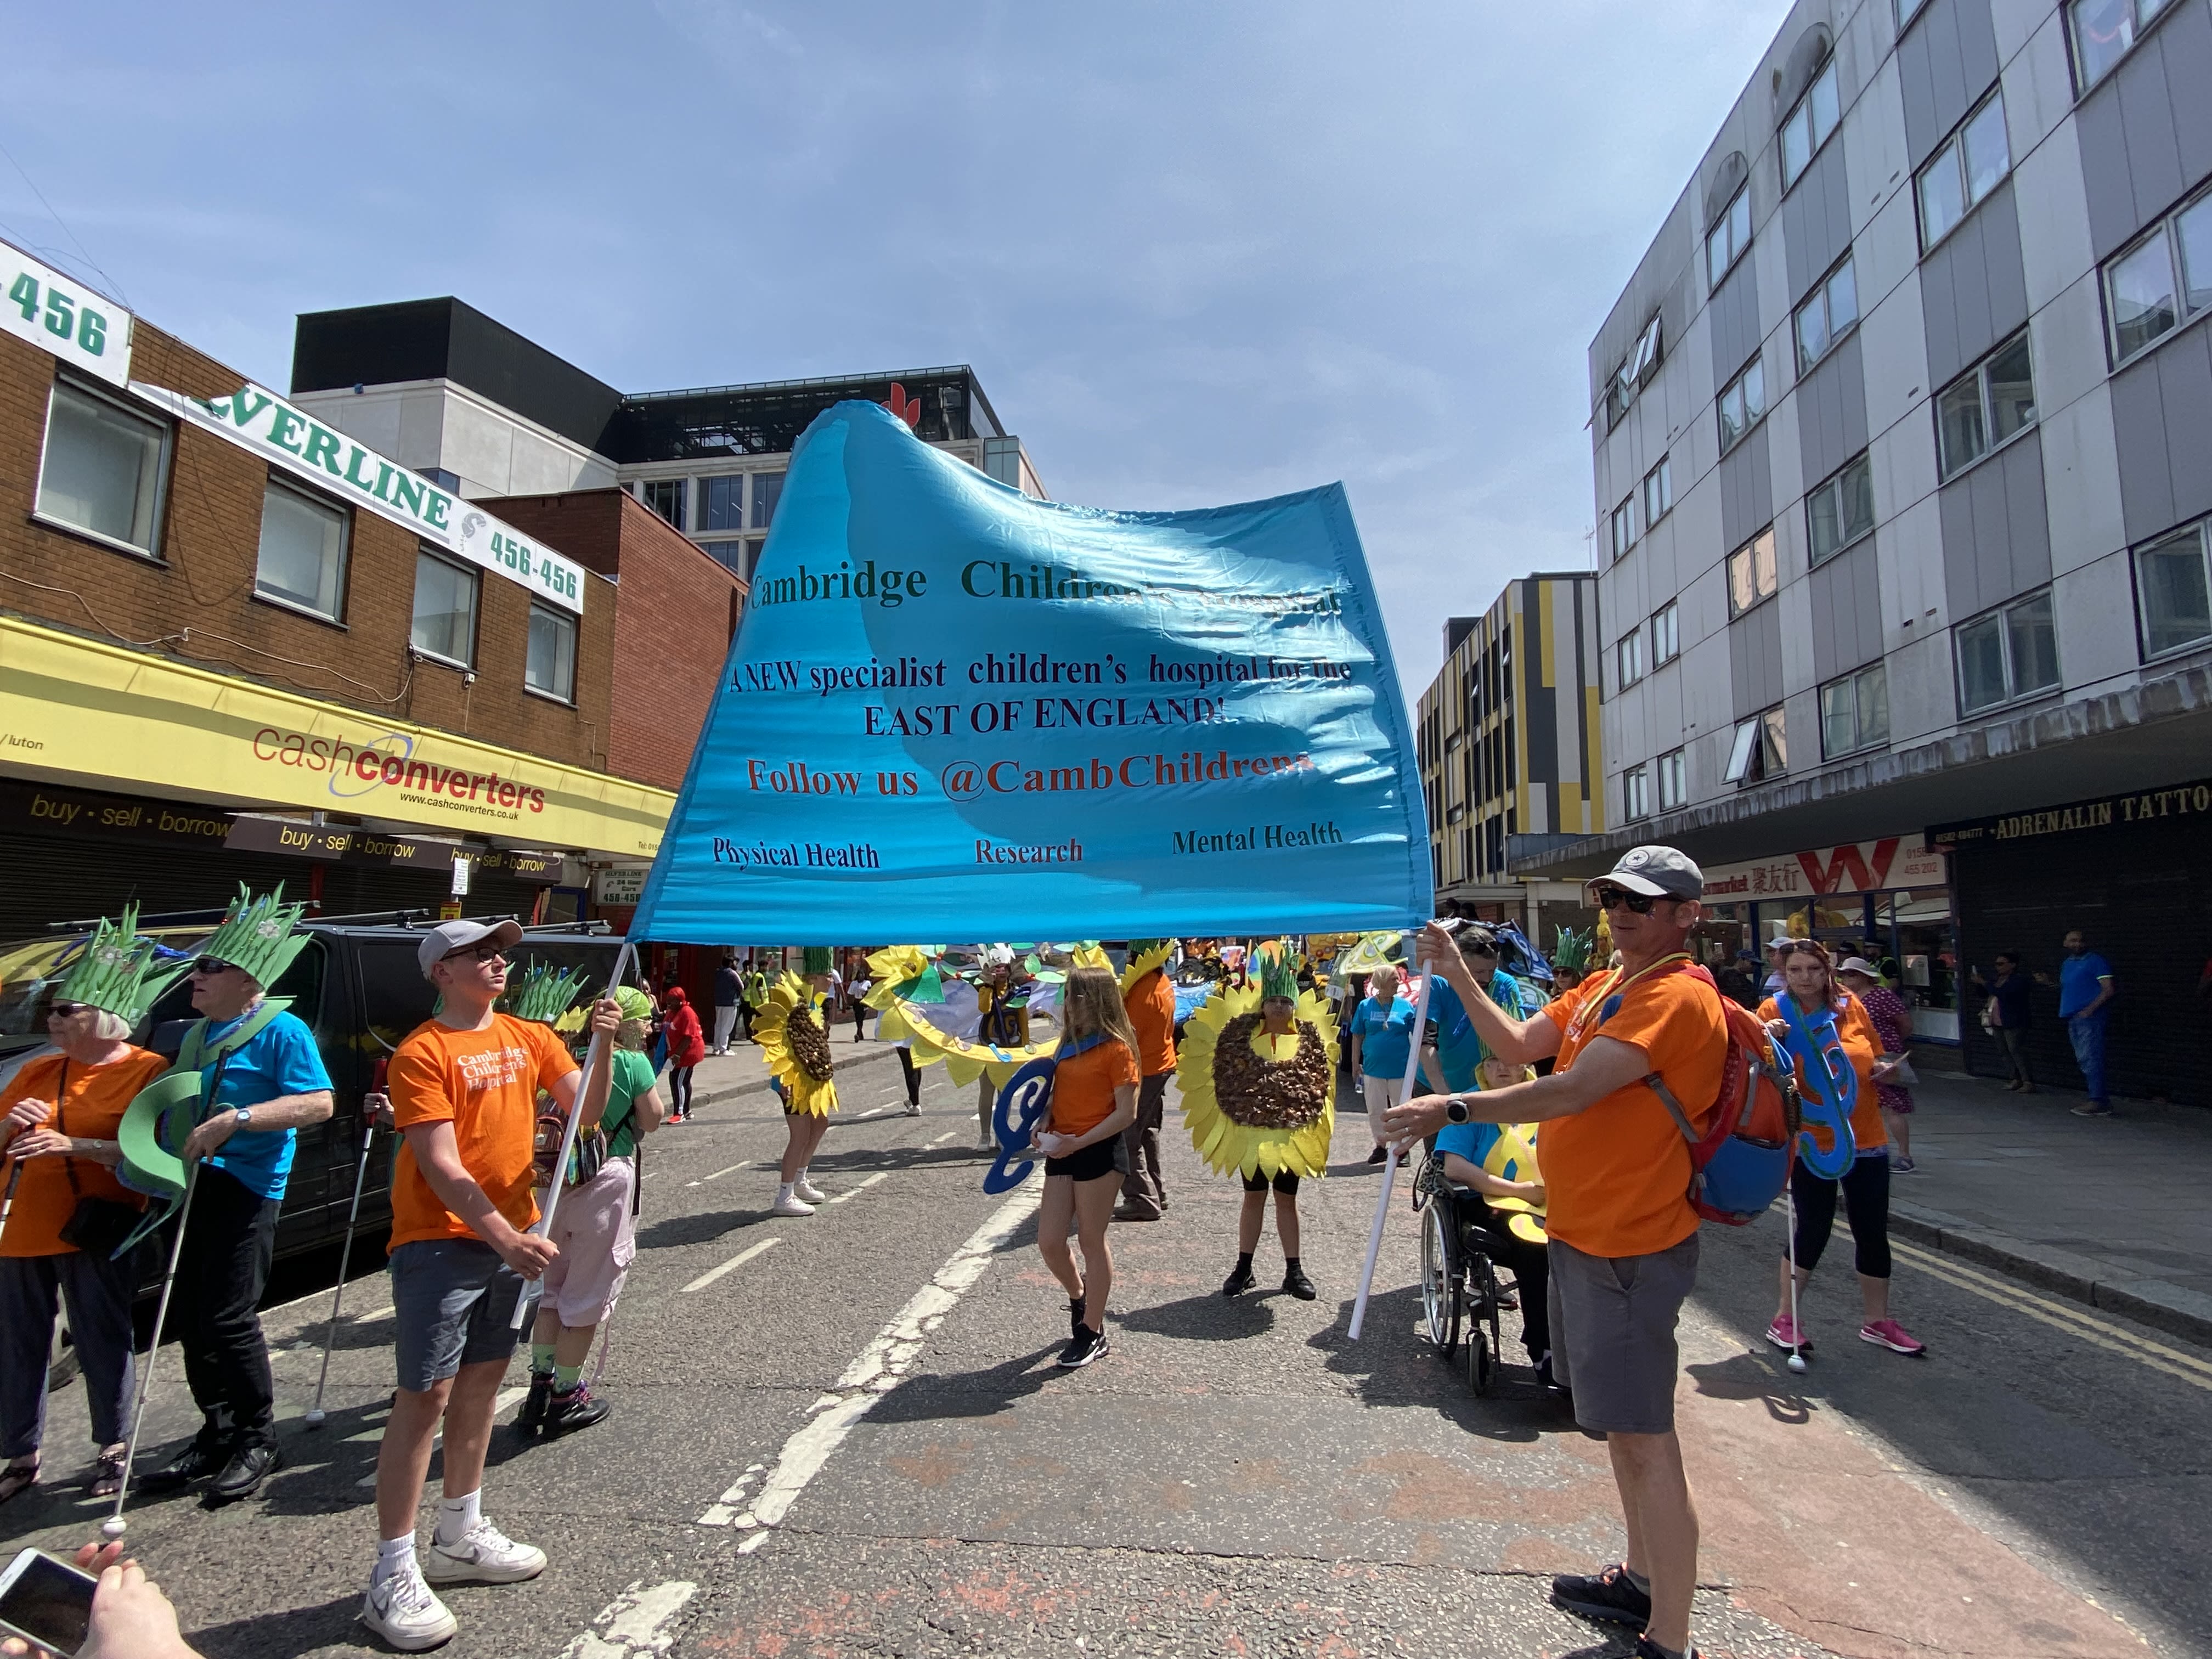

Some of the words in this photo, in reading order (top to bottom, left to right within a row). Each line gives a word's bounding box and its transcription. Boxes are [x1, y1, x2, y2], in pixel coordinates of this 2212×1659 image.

[490, 531, 577, 600] 456-456
[752, 560, 927, 607] Cambridge
[730, 664, 742, 693] A
[744, 660, 802, 692] NEW
[810, 657, 947, 696] specialist
[968, 653, 1126, 685] children's
[1149, 654, 1257, 689] hospital
[1267, 657, 1304, 681] for
[1309, 657, 1351, 680] the
[863, 704, 960, 736] EAST
[970, 701, 1024, 736] OF
[1032, 697, 1225, 729] ENGLAND!
[747, 759, 862, 795] Follow
[876, 770, 918, 796] us
[31, 794, 81, 823] buy
[101, 806, 143, 827] sell
[159, 811, 233, 837] borrow
[400, 792, 519, 821] www.cashconverters.co.uk
[1996, 802, 2112, 840] ADRENALIN
[2120, 784, 2212, 821] TATTO
[280, 825, 314, 850] buy
[326, 832, 352, 851] sell
[364, 837, 416, 859] borrow
[648, 843, 659, 851] 015
[713, 837, 799, 871] Physical
[806, 842, 880, 868] Health
[975, 838, 1083, 864] Research
[1172, 831, 1255, 855] Mental
[1263, 821, 1343, 849] Health
[1906, 845, 1934, 859] 0158
[482, 853, 502, 867] sell
[509, 855, 546, 872] borrow
[458, 1046, 529, 1065] Cambridge
[463, 1059, 527, 1079] Children's
